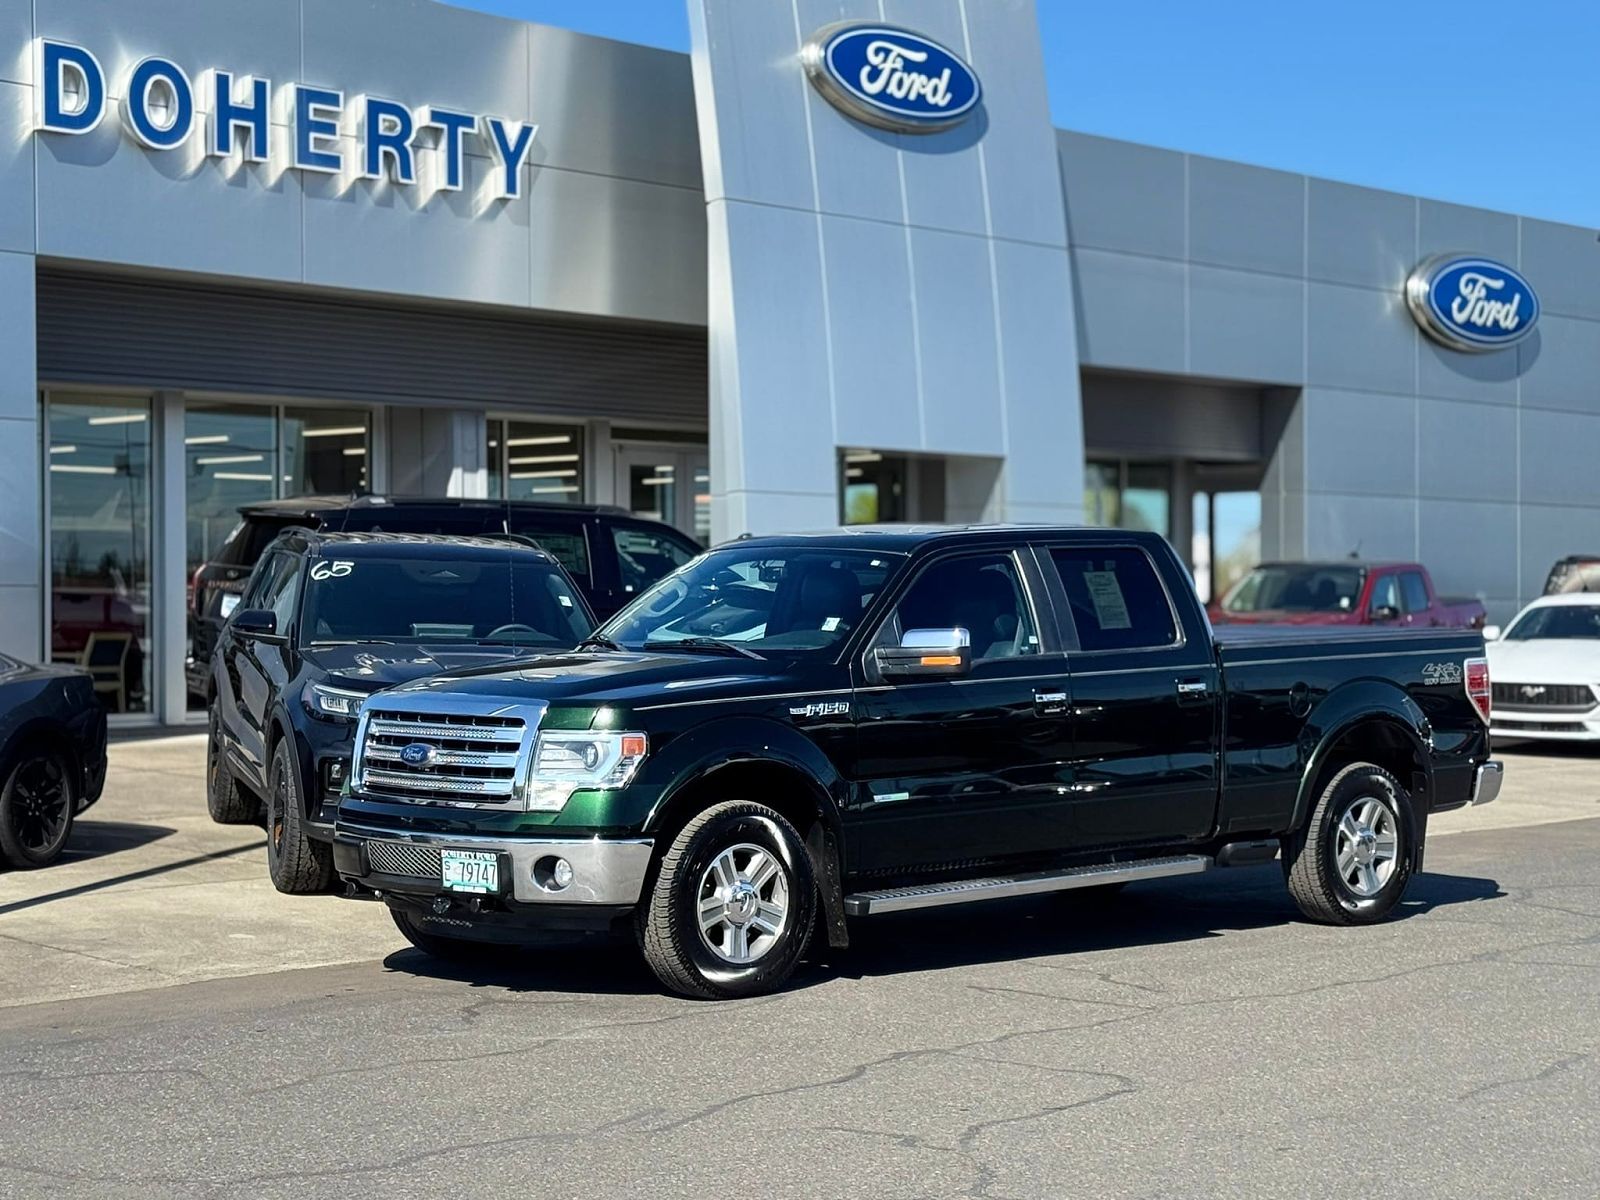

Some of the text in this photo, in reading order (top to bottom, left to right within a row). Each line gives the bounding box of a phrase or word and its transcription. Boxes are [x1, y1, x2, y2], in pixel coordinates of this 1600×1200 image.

[859, 40, 952, 107] Ford
[35, 37, 538, 200] DOHERTY
[1451, 271, 1521, 331] Ford
[311, 560, 355, 580] 65
[459, 861, 496, 886] 79747
[476, 853, 497, 862] FORD
